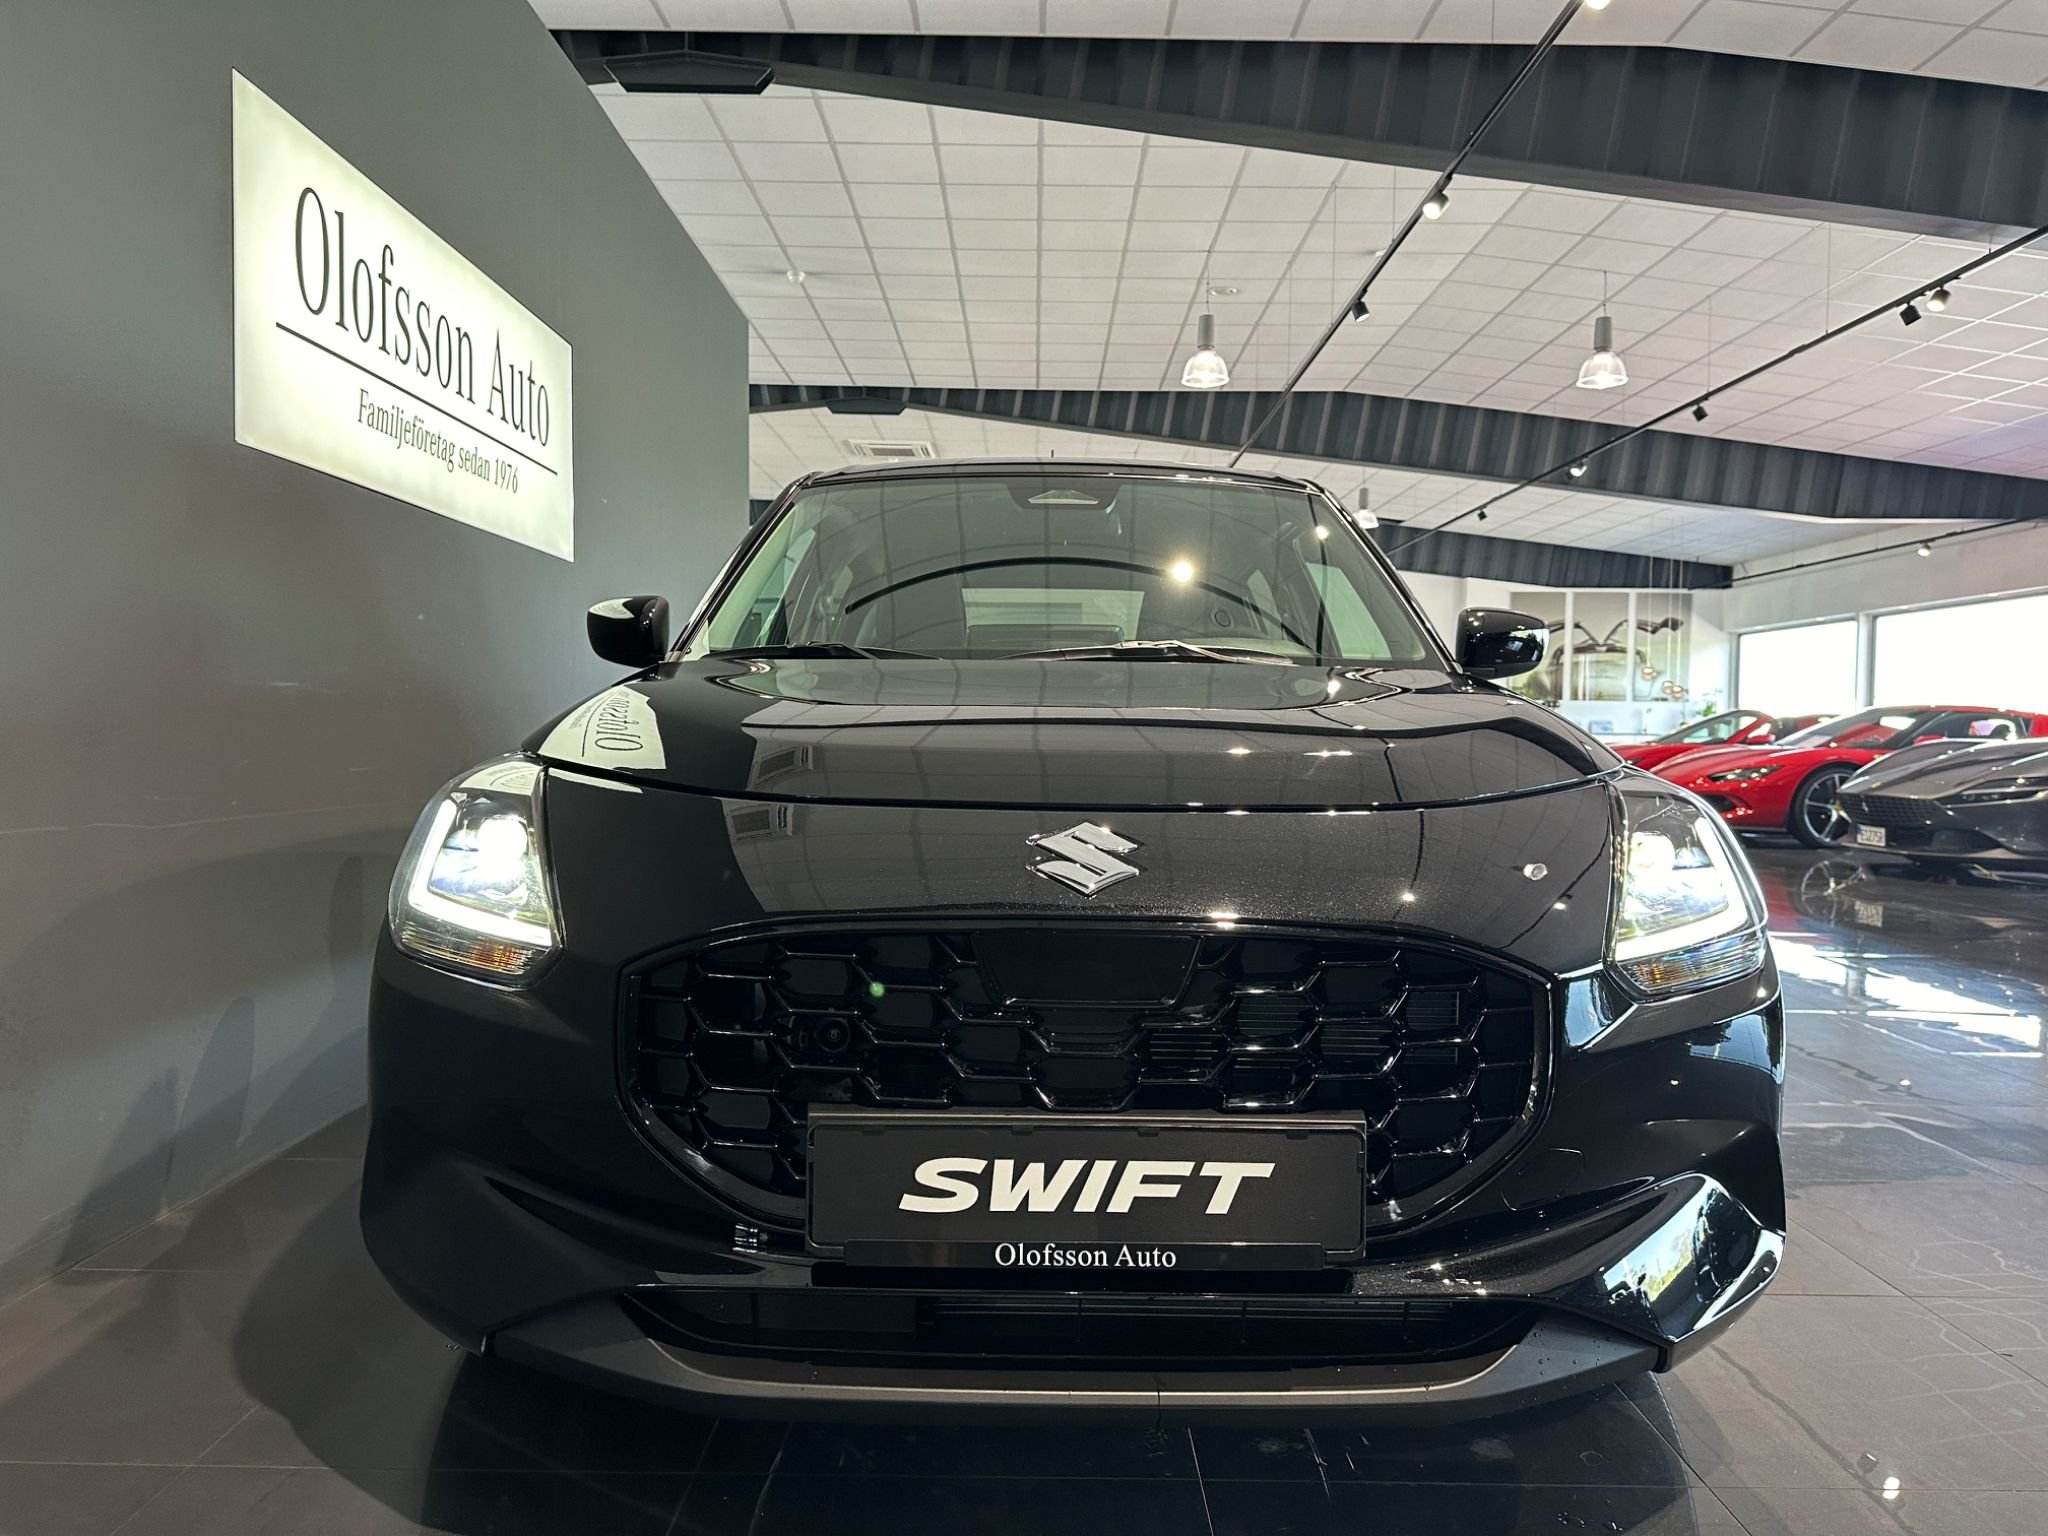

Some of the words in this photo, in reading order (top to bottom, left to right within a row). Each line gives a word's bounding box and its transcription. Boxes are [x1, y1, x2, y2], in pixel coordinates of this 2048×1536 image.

[296, 188, 476, 405] Olofsson
[487, 329, 550, 447] Auto
[357, 388, 456, 473] Familjeföretag
[458, 446, 491, 480] sedan
[495, 457, 518, 495] 1976
[899, 1157, 1275, 1214] SWIFT
[994, 1242, 1107, 1267] Olofsson
[1114, 1244, 1177, 1267] Auto
